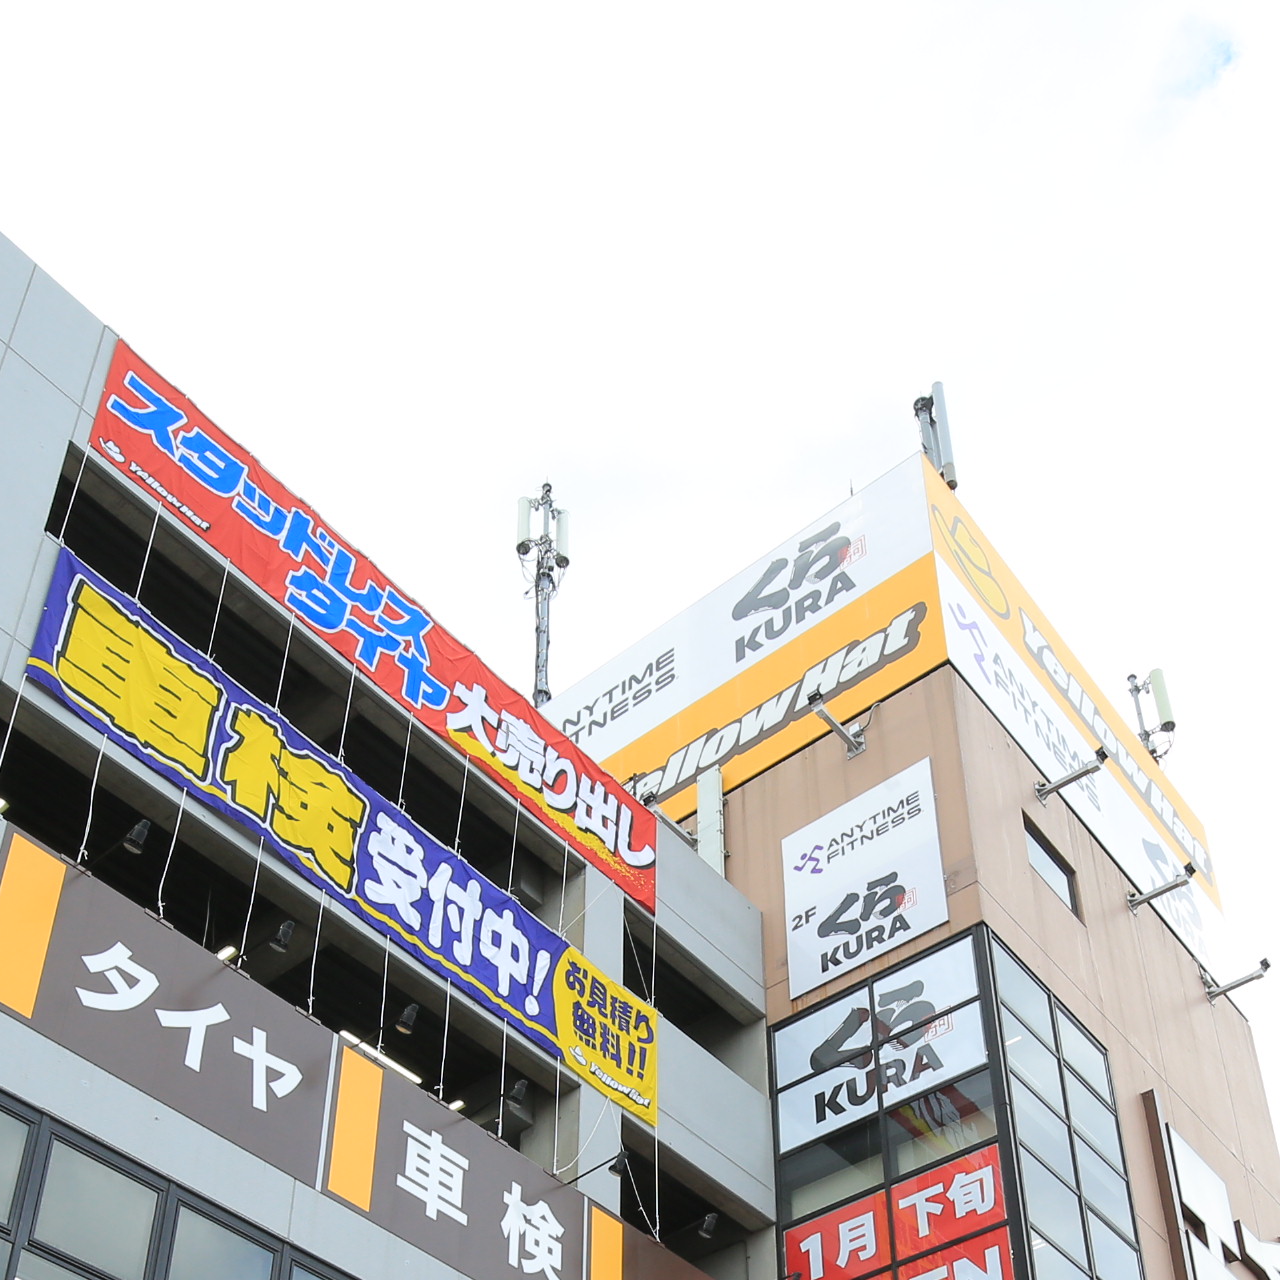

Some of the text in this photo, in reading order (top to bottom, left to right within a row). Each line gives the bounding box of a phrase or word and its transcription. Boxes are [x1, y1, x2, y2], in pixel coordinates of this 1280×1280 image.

[109, 371, 436, 669] スタッドレス
[732, 521, 851, 621] くら
[284, 570, 450, 709] タイヤ
[735, 571, 856, 663] KURA
[562, 648, 675, 732] NYTIME
[569, 672, 678, 747] TNESS
[622, 603, 926, 798] ellowHat
[446, 680, 656, 868] 大売り出し
[1019, 607, 1213, 886] YellowHat
[827, 790, 919, 851] ANYTIME
[827, 804, 921, 864] FITNESS
[792, 906, 816, 931] 2F
[817, 871, 906, 939] くら
[821, 914, 911, 973] KURA
[76, 941, 302, 1111] タイヤ
[566, 960, 654, 1045] お見積り
[816, 1043, 943, 1124] KURA
